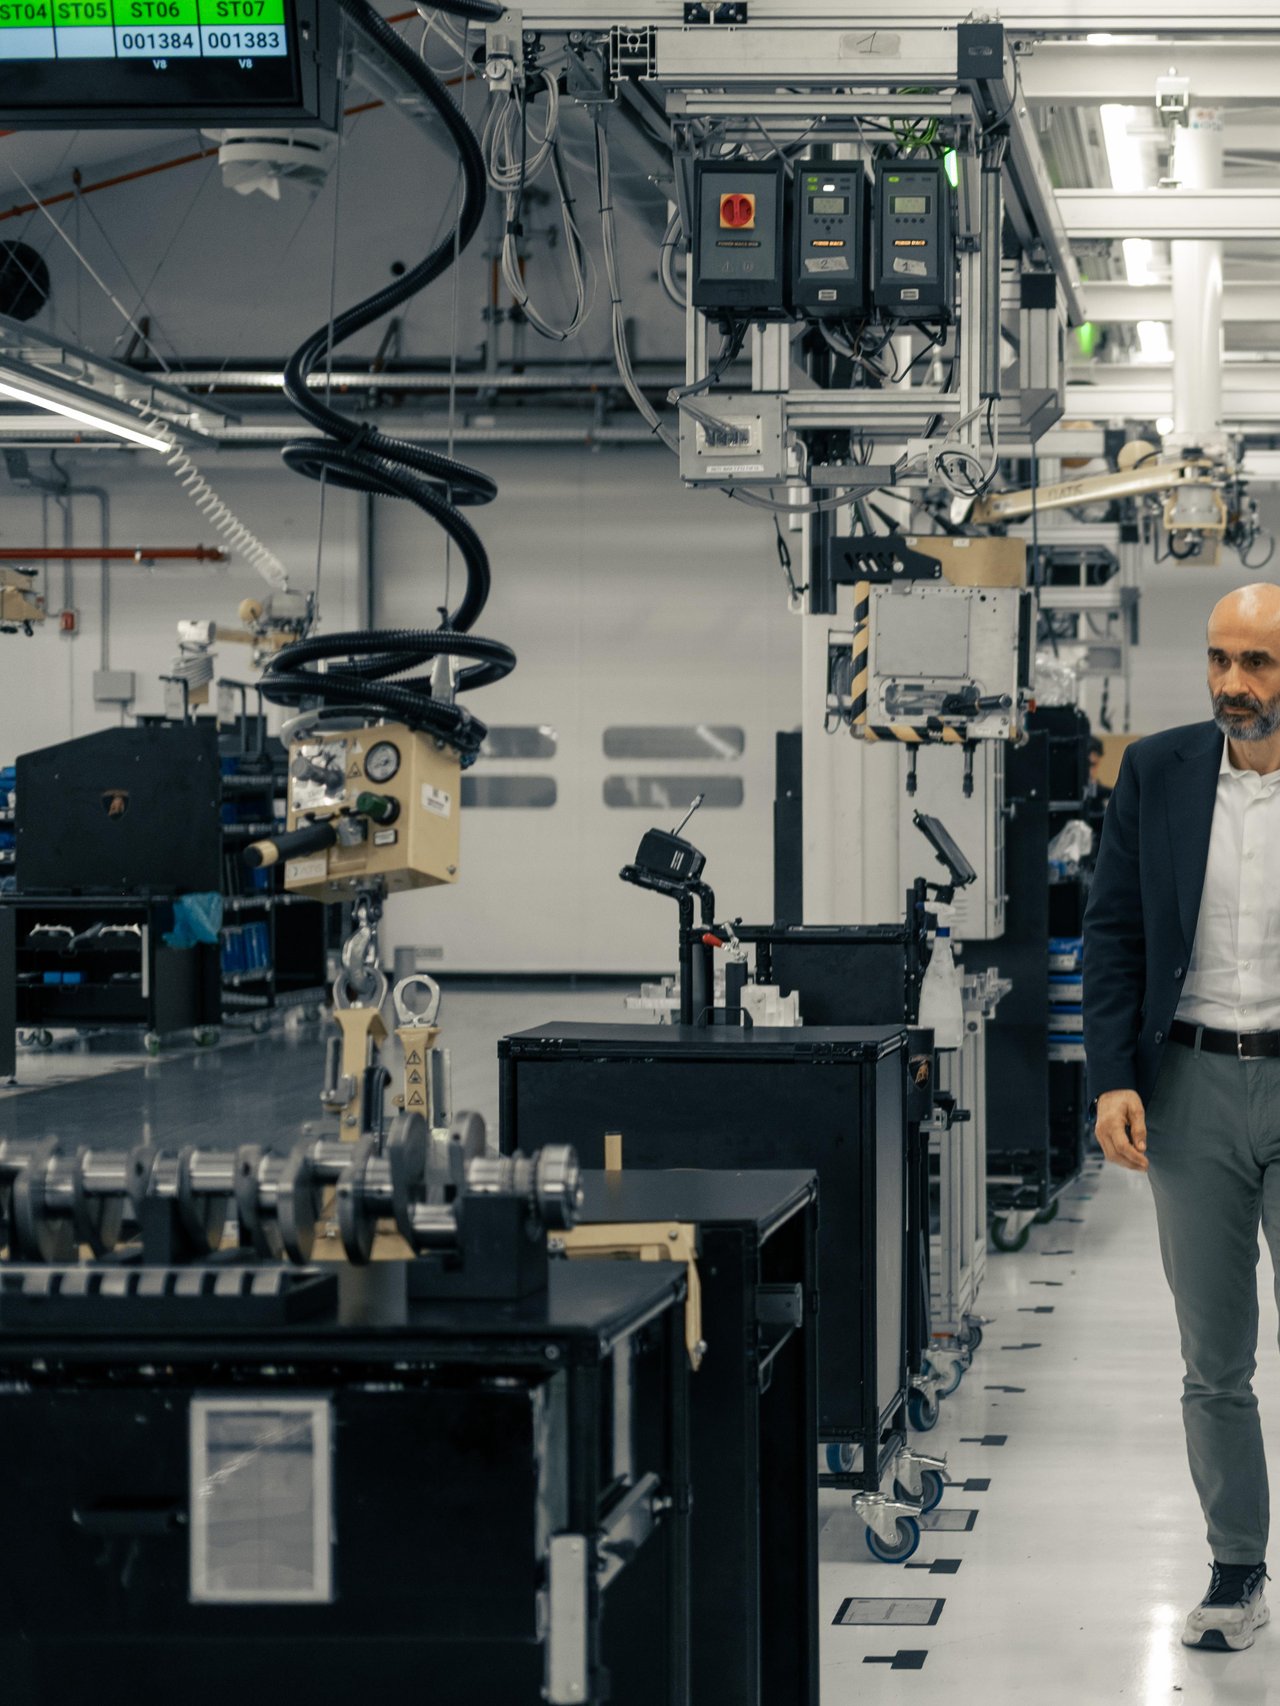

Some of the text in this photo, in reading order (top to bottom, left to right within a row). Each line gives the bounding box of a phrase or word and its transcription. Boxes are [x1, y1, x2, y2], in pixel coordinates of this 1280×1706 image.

[0, 4, 47, 20] ST04
[58, 2, 107, 19] ST05
[131, 1, 180, 18] ST06
[216, 0, 265, 17] ST07
[122, 33, 194, 49] 001384
[208, 32, 280, 48] 001383
[153, 59, 168, 70] V8
[239, 58, 253, 69] V8
[820, 259, 828, 270] 2
